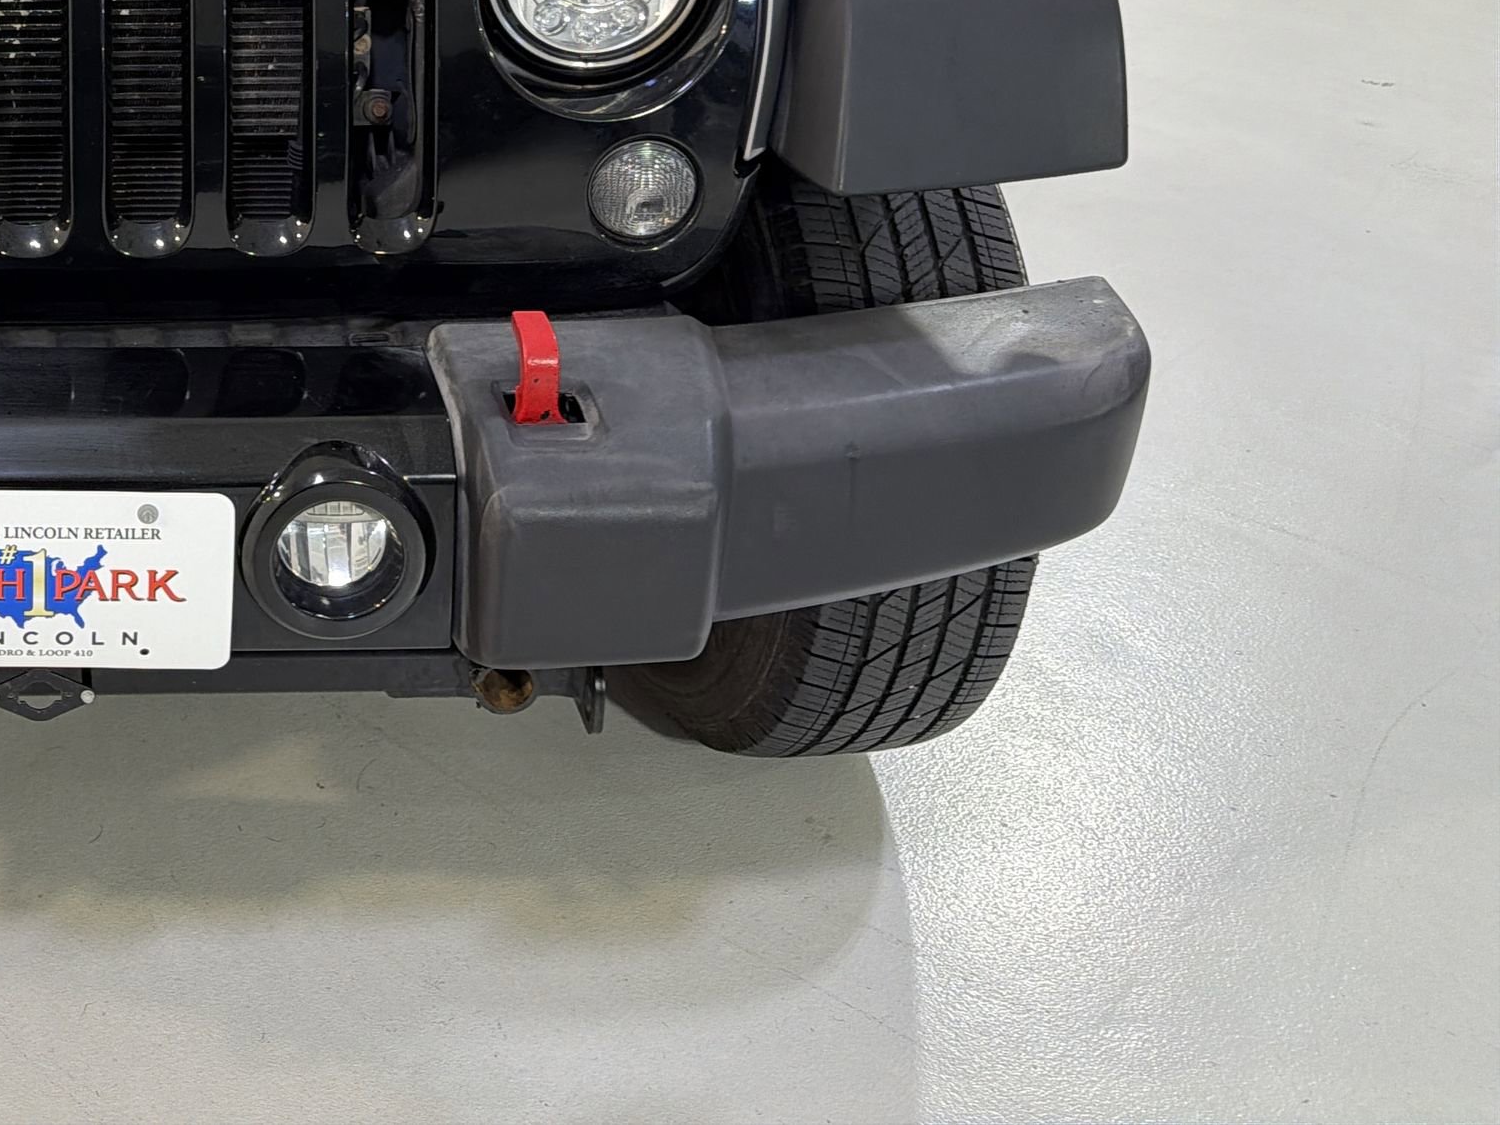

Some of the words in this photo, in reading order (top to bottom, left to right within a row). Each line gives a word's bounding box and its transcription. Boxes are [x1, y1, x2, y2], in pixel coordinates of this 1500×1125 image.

[3, 527, 79, 540] LINCOLN
[83, 527, 162, 541] RETAILER
[53, 569, 188, 603] PARK
[26, 648, 37, 657] &
[39, 649, 71, 657] LOOP
[73, 649, 94, 657] 410
